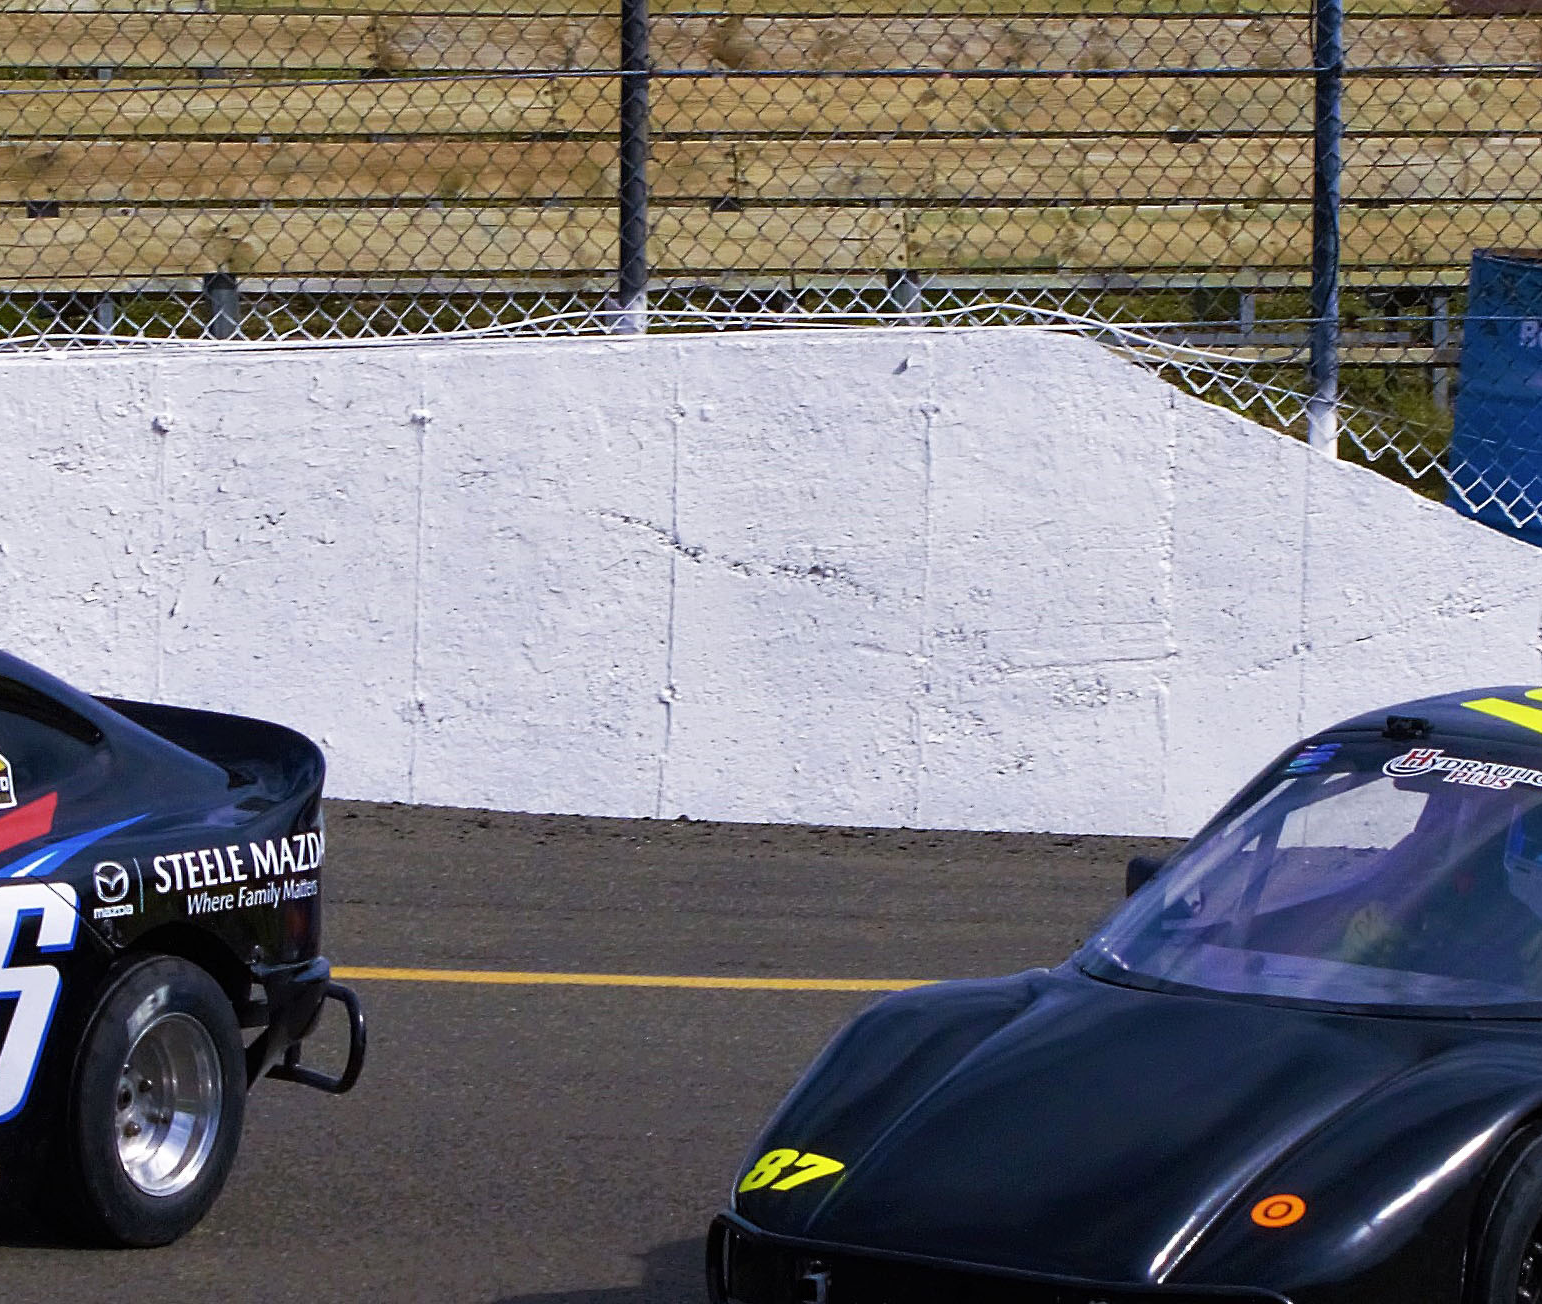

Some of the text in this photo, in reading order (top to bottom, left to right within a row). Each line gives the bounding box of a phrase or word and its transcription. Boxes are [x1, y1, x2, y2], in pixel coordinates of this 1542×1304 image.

[1444, 769, 1517, 791] PLUS
[154, 845, 247, 893] STEELE
[188, 893, 234, 915] Where
[238, 881, 281, 909] Family
[738, 1148, 845, 1193] 87
